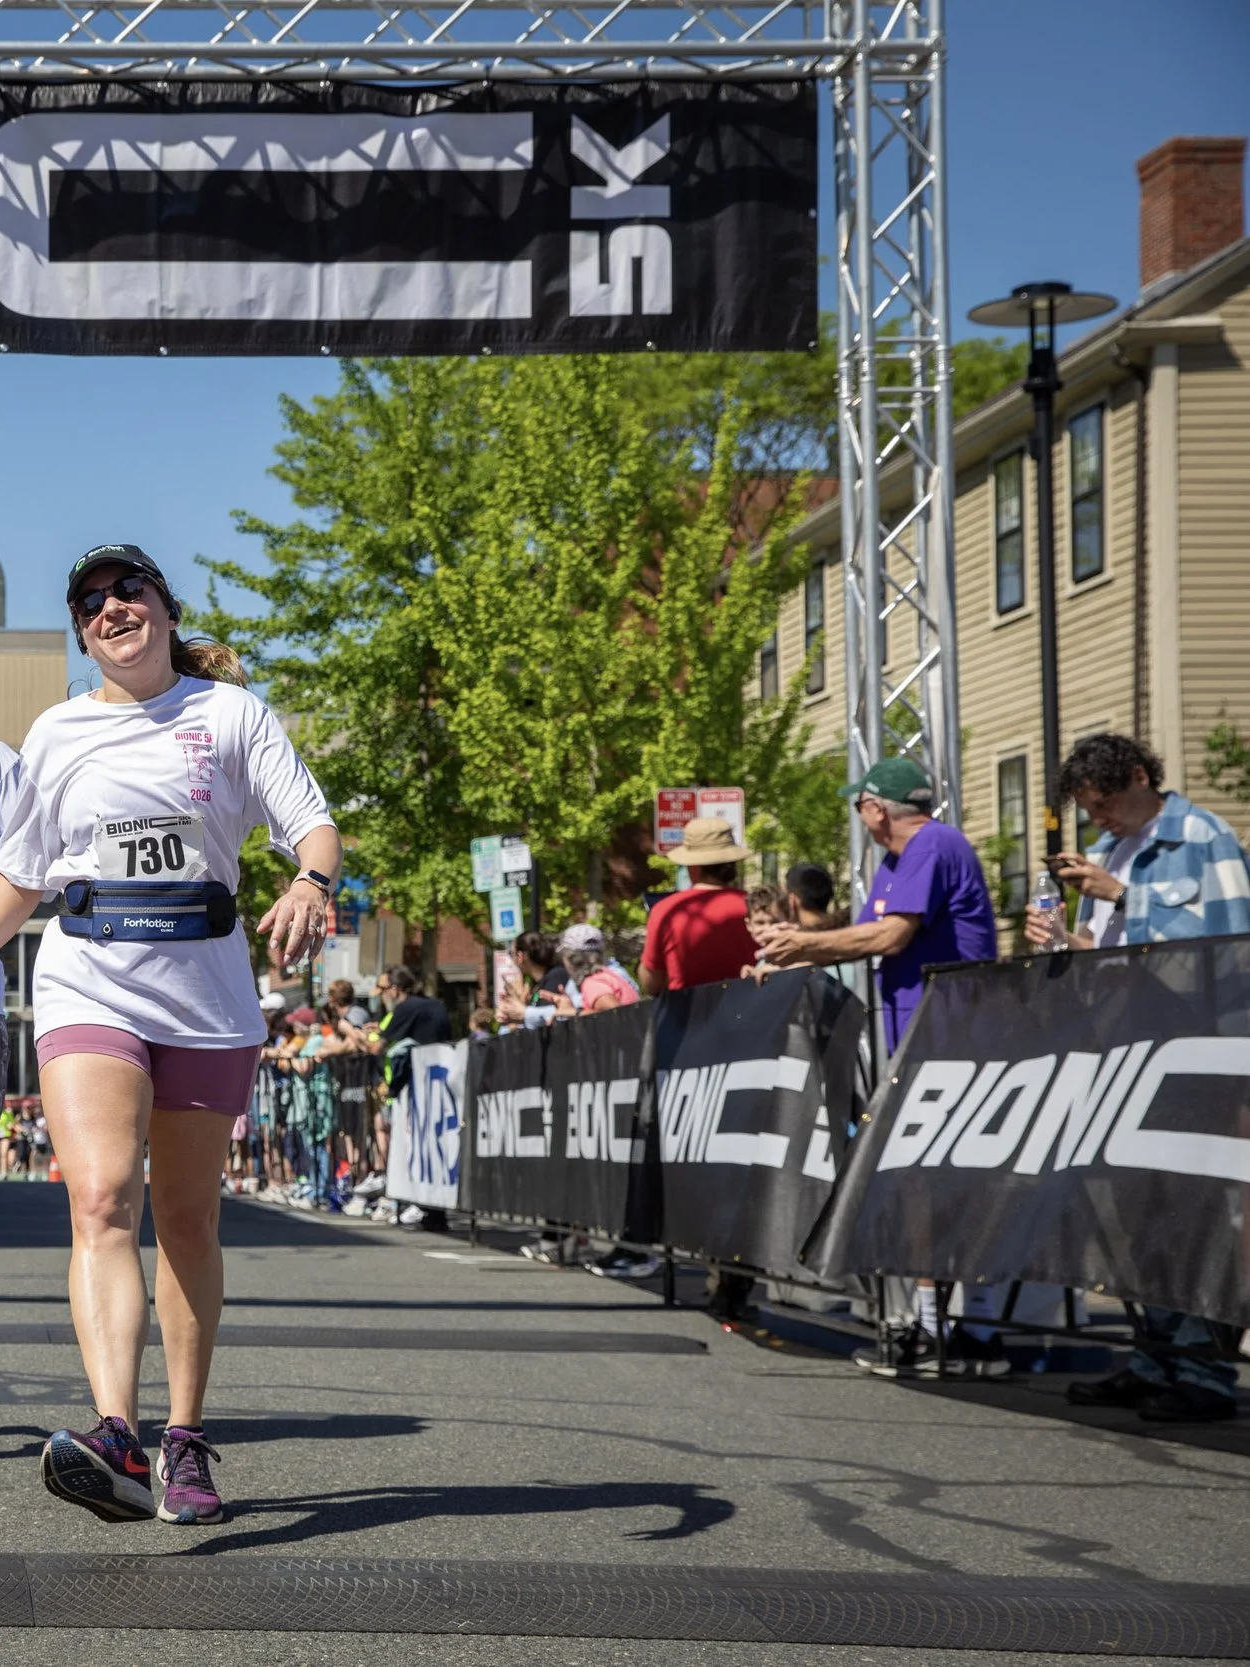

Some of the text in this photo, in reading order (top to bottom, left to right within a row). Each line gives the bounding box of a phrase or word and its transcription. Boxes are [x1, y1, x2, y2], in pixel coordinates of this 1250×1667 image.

[570, 112, 673, 317] 5K
[175, 732, 203, 742] BIONIC
[190, 789, 212, 802] 2026
[106, 816, 178, 835] BIONIC
[118, 833, 186, 878] 730
[123, 917, 174, 928] ForMotion
